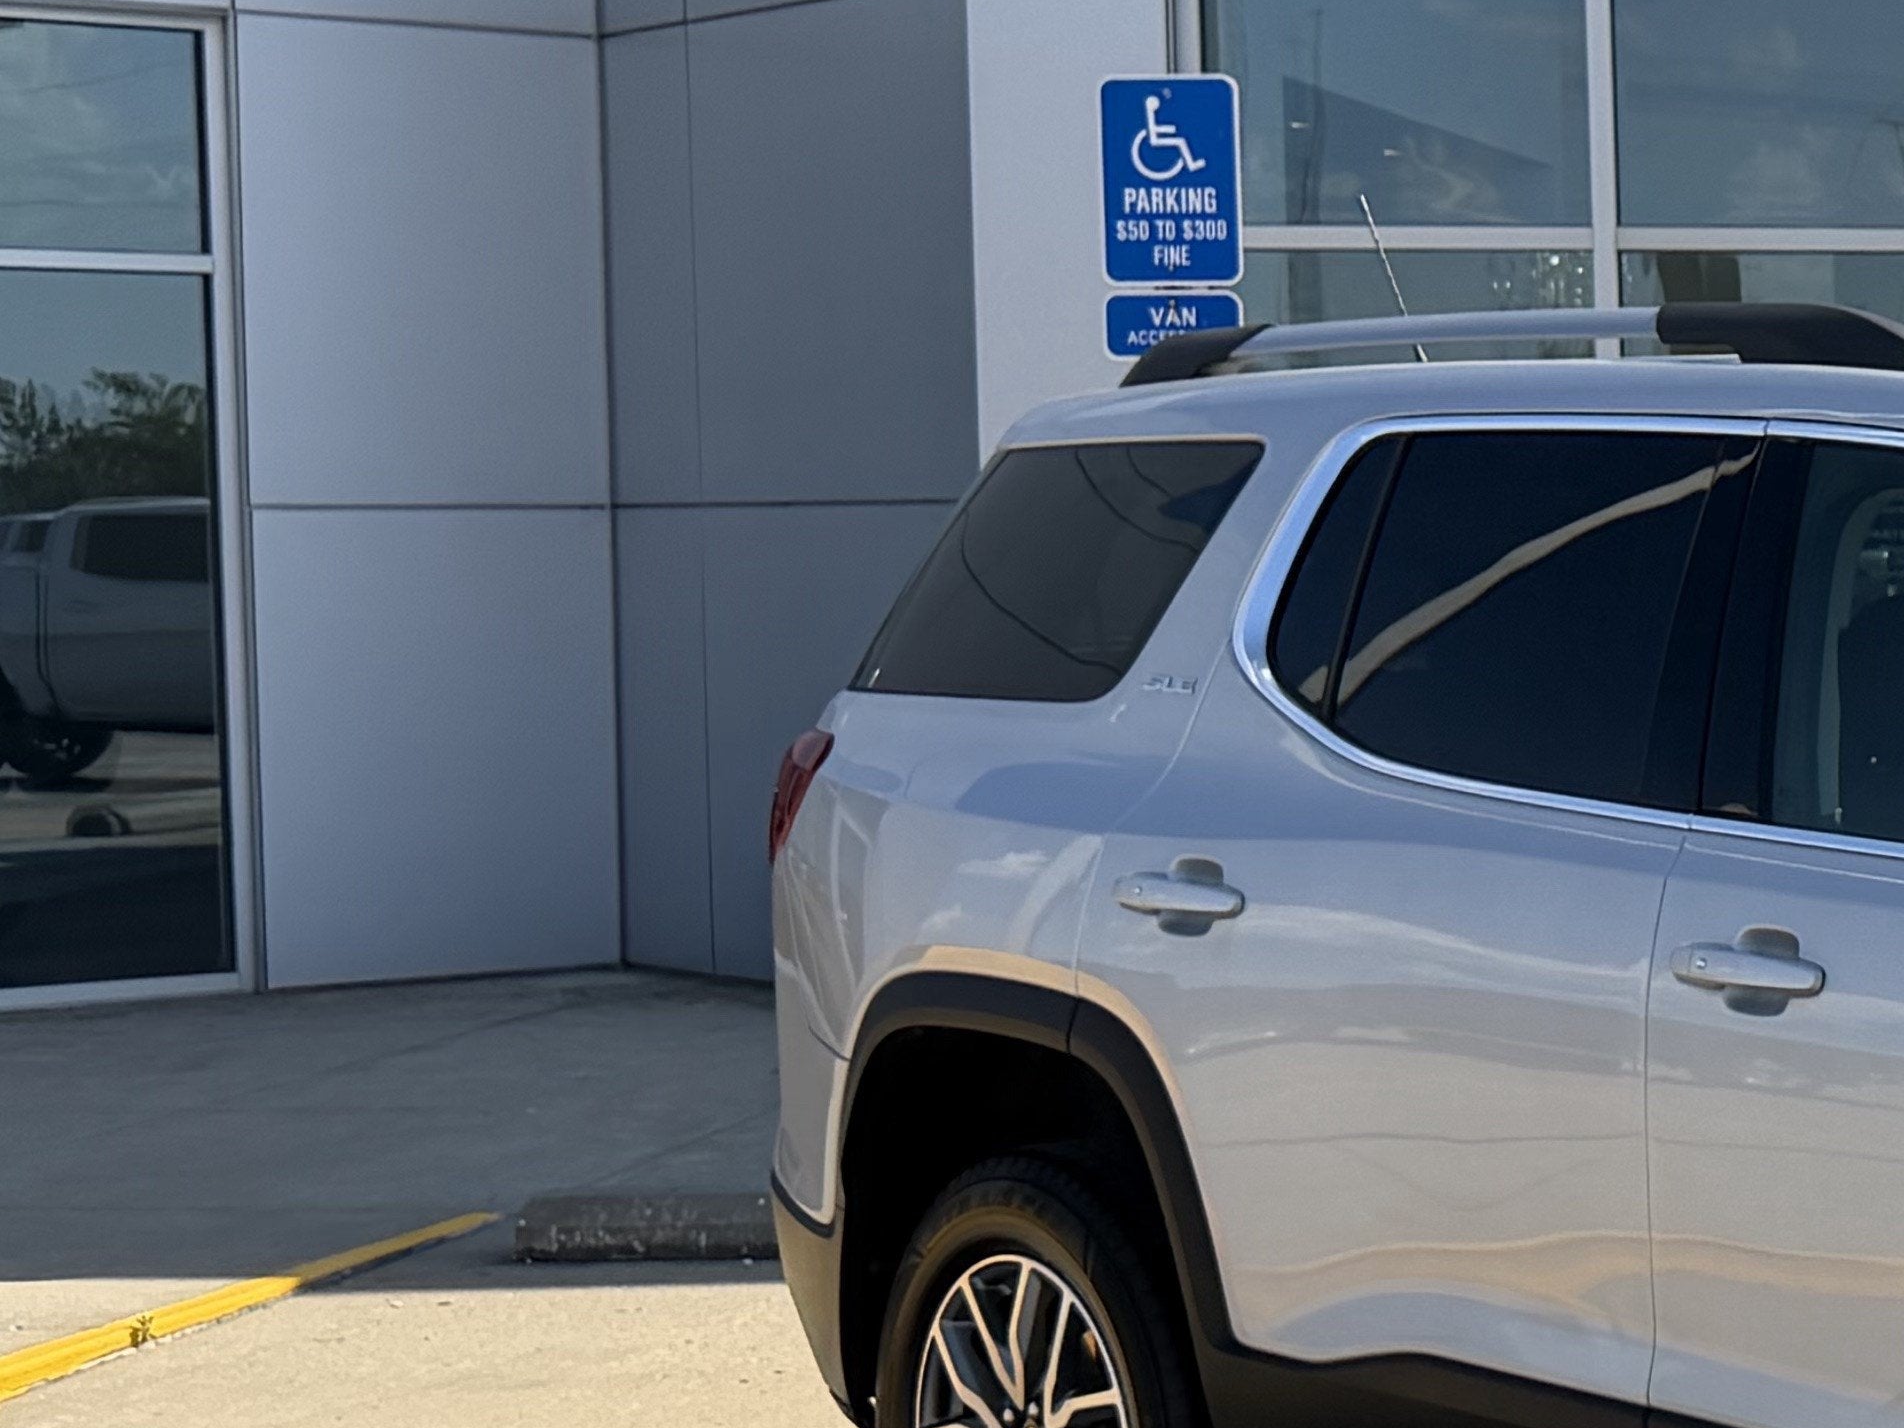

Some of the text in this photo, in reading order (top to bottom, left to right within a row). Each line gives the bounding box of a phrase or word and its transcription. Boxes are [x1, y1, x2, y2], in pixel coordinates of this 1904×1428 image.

[1123, 187, 1217, 215] PARKING
[1116, 218, 1228, 241] $50 TO $300
[1153, 244, 1191, 267] FINE
[1150, 306, 1197, 327] VAN
